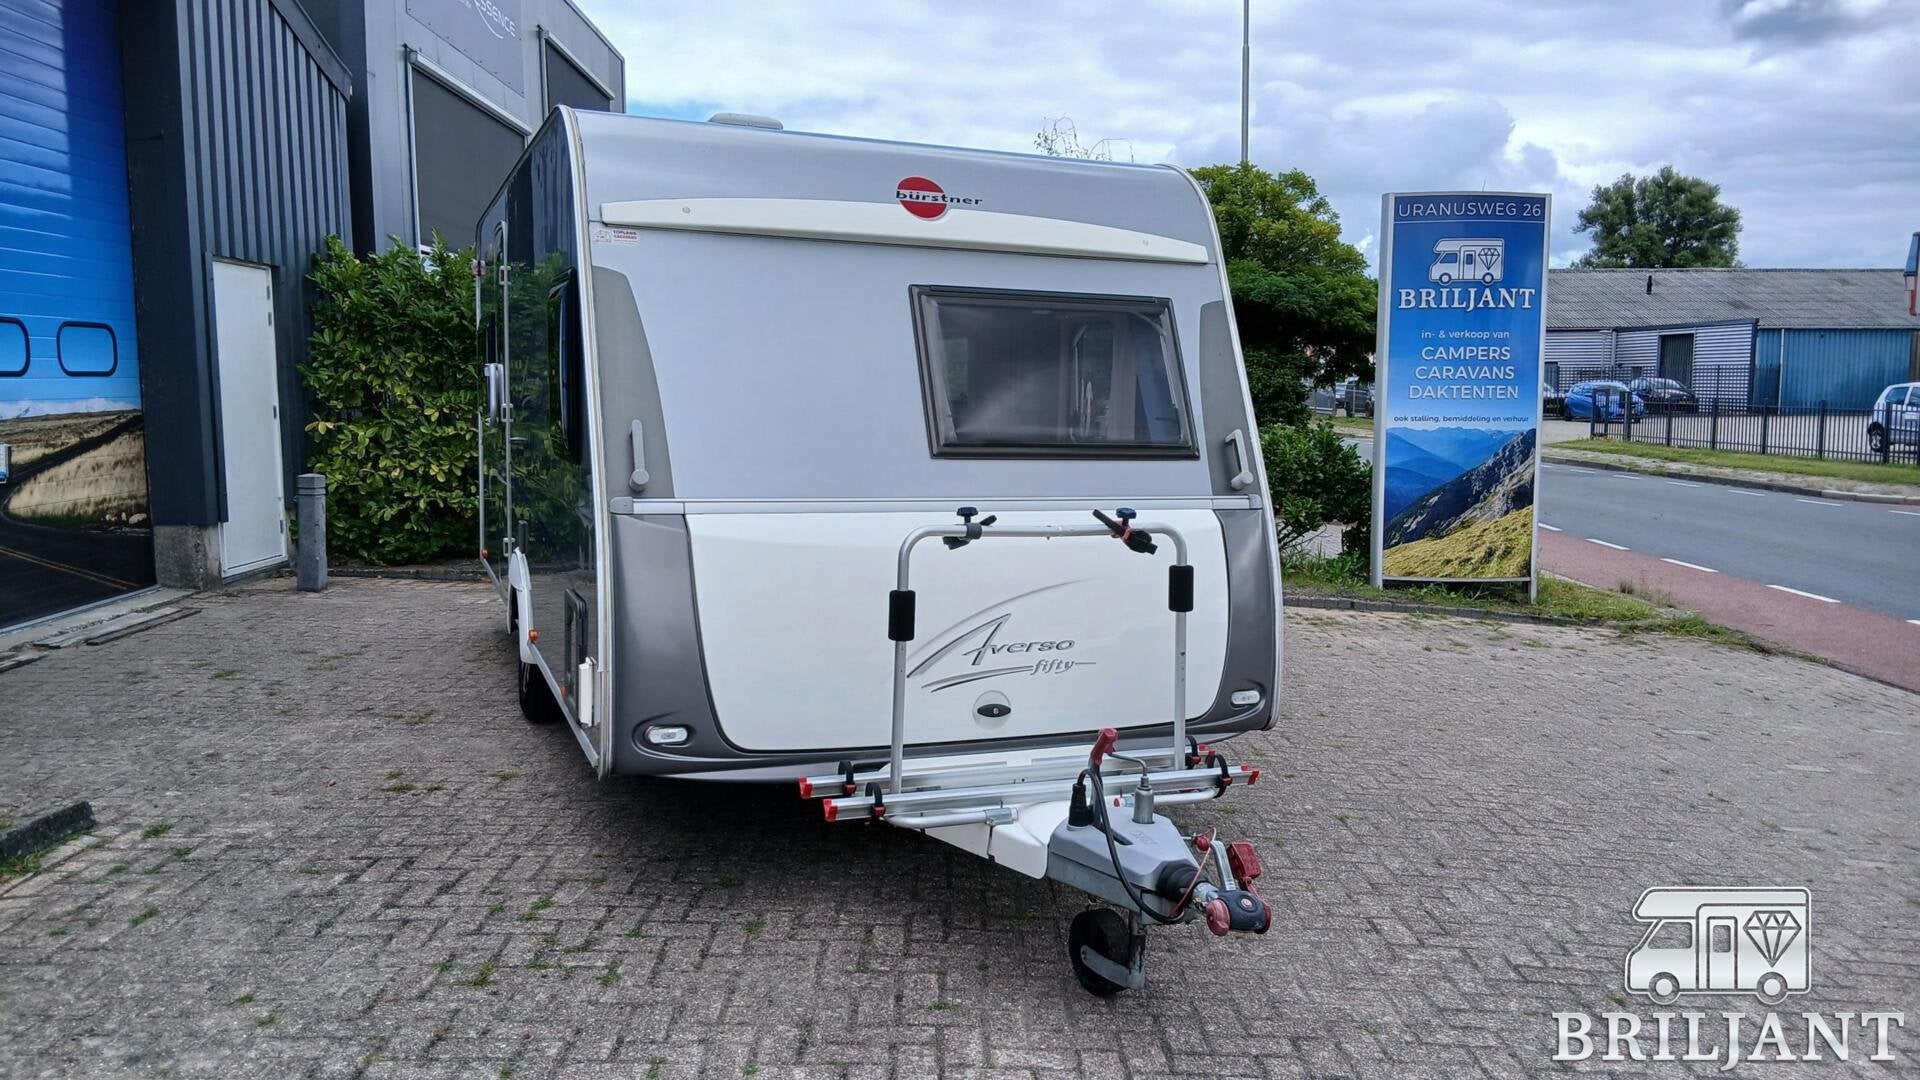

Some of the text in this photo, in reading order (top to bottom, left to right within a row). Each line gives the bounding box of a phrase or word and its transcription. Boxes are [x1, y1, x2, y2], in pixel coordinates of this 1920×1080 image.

[896, 190, 983, 205] bürstner
[1398, 202, 1541, 217] URANUSWEG 26
[1398, 287, 1536, 312] BRILJANT
[1421, 330, 1510, 341] in- & verkoop van
[1421, 346, 1511, 361] CAMPERS
[1415, 366, 1515, 380] CARAVANS
[1408, 385, 1519, 399] DAKTENTEN
[1410, 415, 1441, 424] stalling,
[1443, 415, 1490, 424] bemiddeling
[907, 613, 1076, 678] Averso
[1030, 658, 1075, 676] fifty
